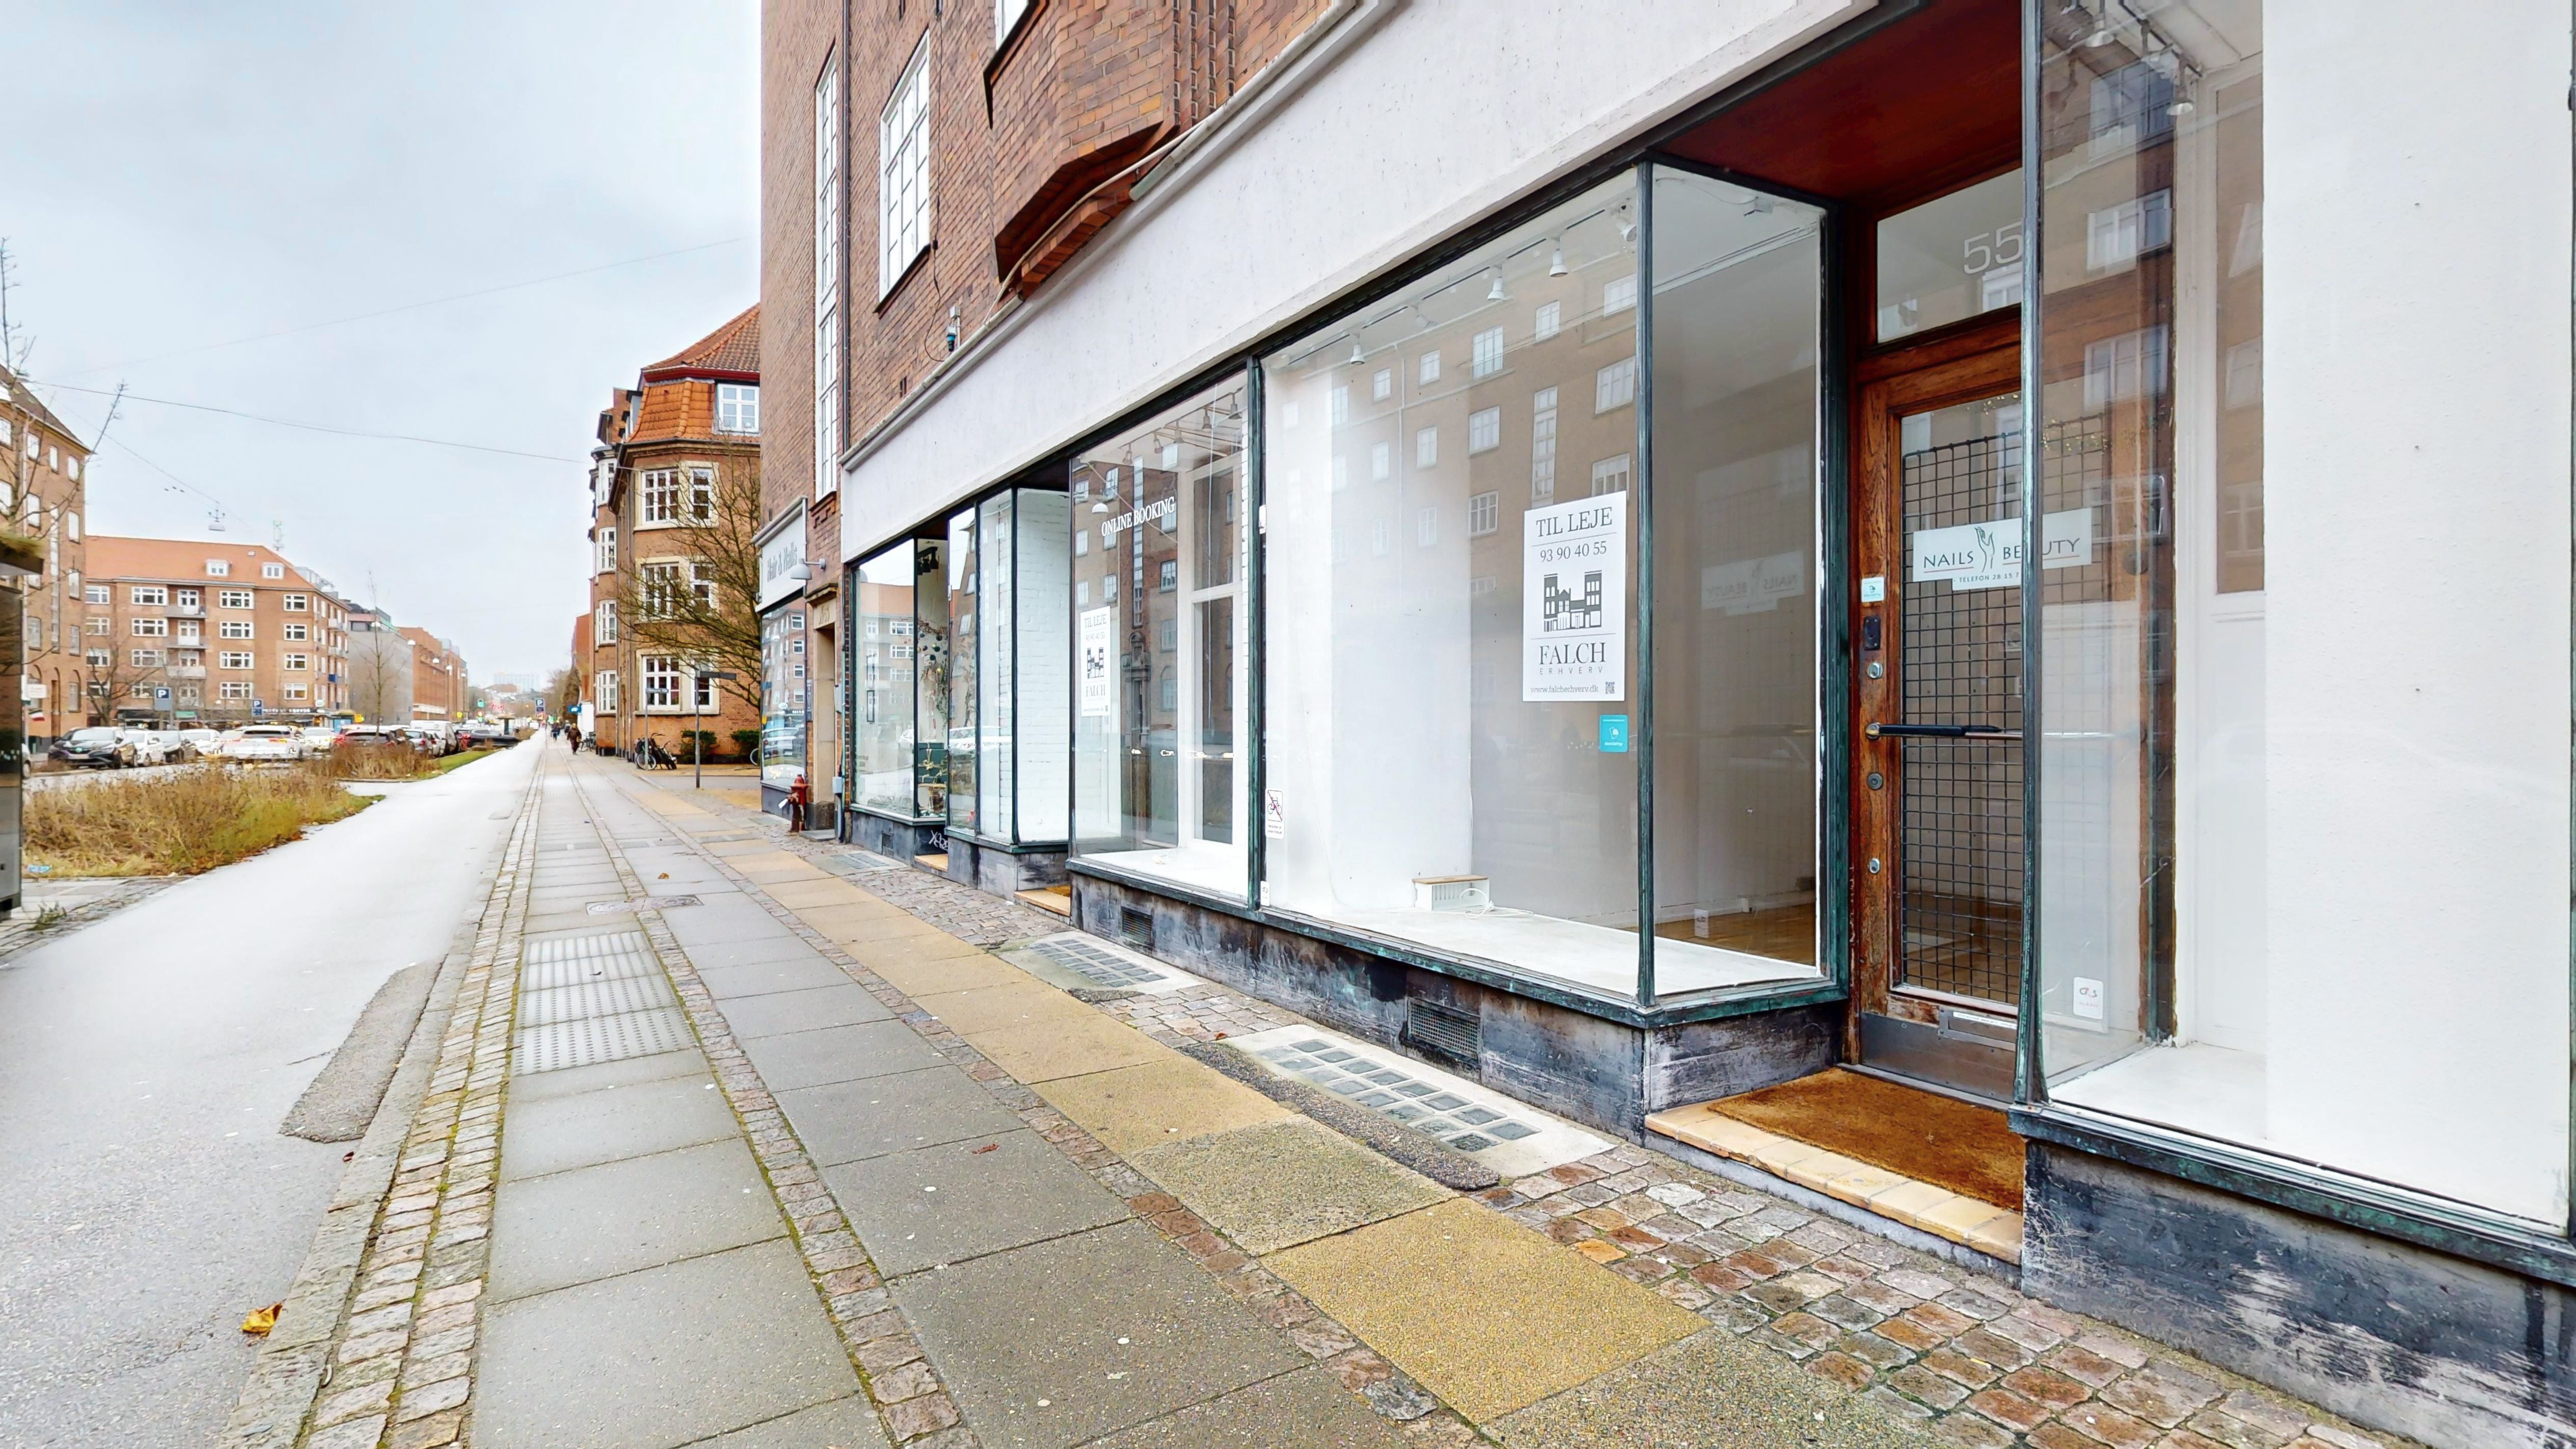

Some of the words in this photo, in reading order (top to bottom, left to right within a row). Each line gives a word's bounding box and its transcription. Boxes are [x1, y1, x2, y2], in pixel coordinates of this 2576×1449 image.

[1964, 221, 2022, 274] 55
[1101, 512, 1132, 536] ONLINE
[1134, 497, 1175, 526] BOOKING
[1536, 516, 1563, 537] TIL
[1567, 506, 1612, 532] LEJE
[1540, 549, 1553, 562] 93
[1557, 546, 1571, 560] 90
[1575, 543, 1589, 557] 40
[1593, 540, 1607, 555] 55
[1923, 551, 1974, 568] NAILS
[2003, 538, 2080, 560] BEUTY
[1959, 574, 1990, 583] TELEFON
[1539, 642, 1607, 665] FALCH
[1539, 666, 1603, 675] ERHVERV
[158, 690, 167, 698] P
[1530, 685, 1598, 693] www.falcherhverv.dk
